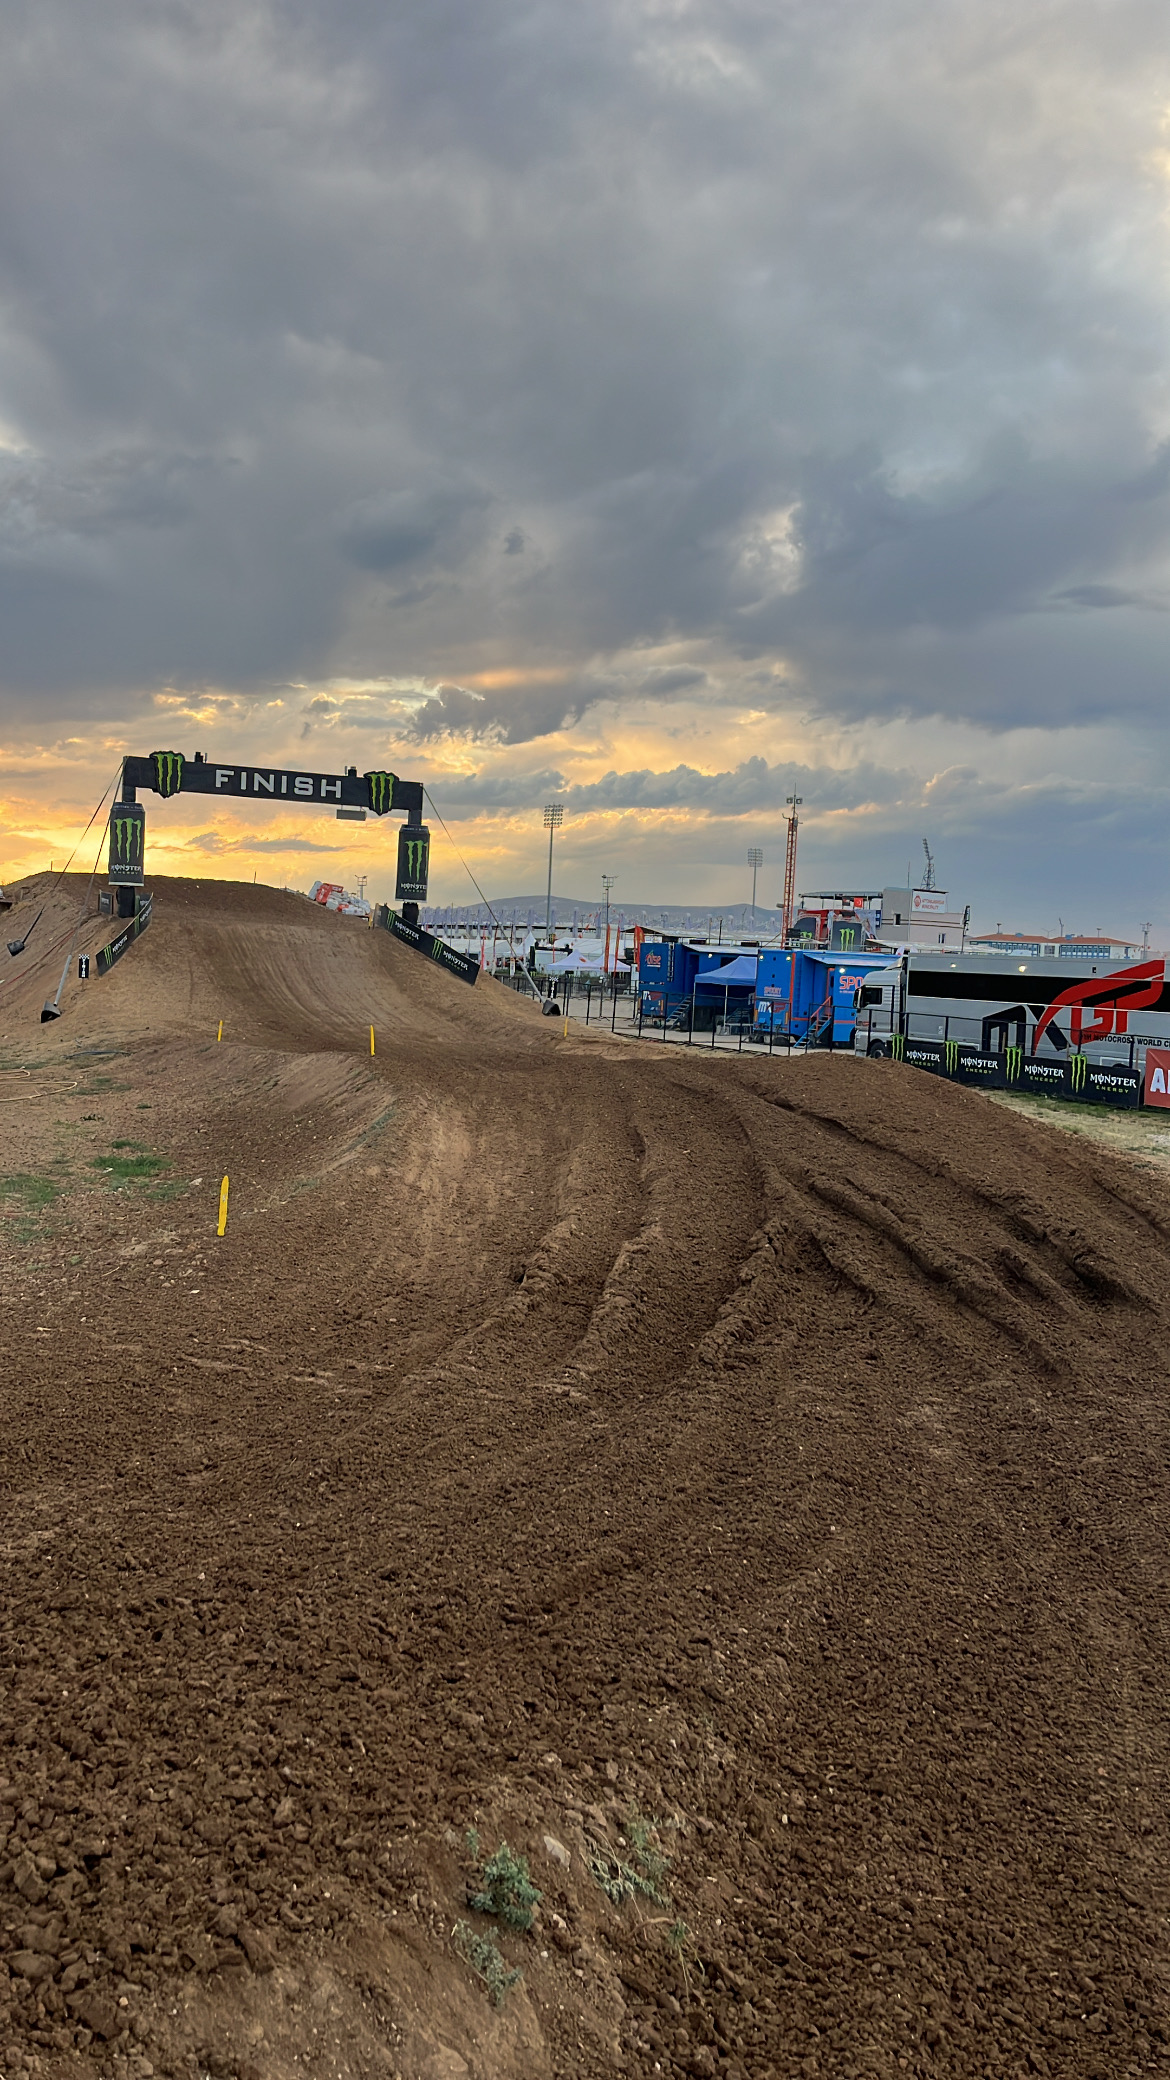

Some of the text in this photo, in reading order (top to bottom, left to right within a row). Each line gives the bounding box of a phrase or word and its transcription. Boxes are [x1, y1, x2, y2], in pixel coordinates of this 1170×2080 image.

[215, 769, 342, 799] FINISH
[401, 882, 427, 890] MONSTE
[1136, 1037, 1162, 1047] WORLD
[906, 1049, 941, 1062] MONSTER
[960, 1056, 999, 1070] MONSTER
[965, 1067, 993, 1075] ENERGY
[1024, 1064, 1065, 1078] MONSTER
[1029, 1075, 1058, 1083] ENERGY
[1089, 1073, 1137, 1089] MONSTER
[1149, 1067, 1170, 1095] A
[1095, 1085, 1129, 1094] ENERGY
